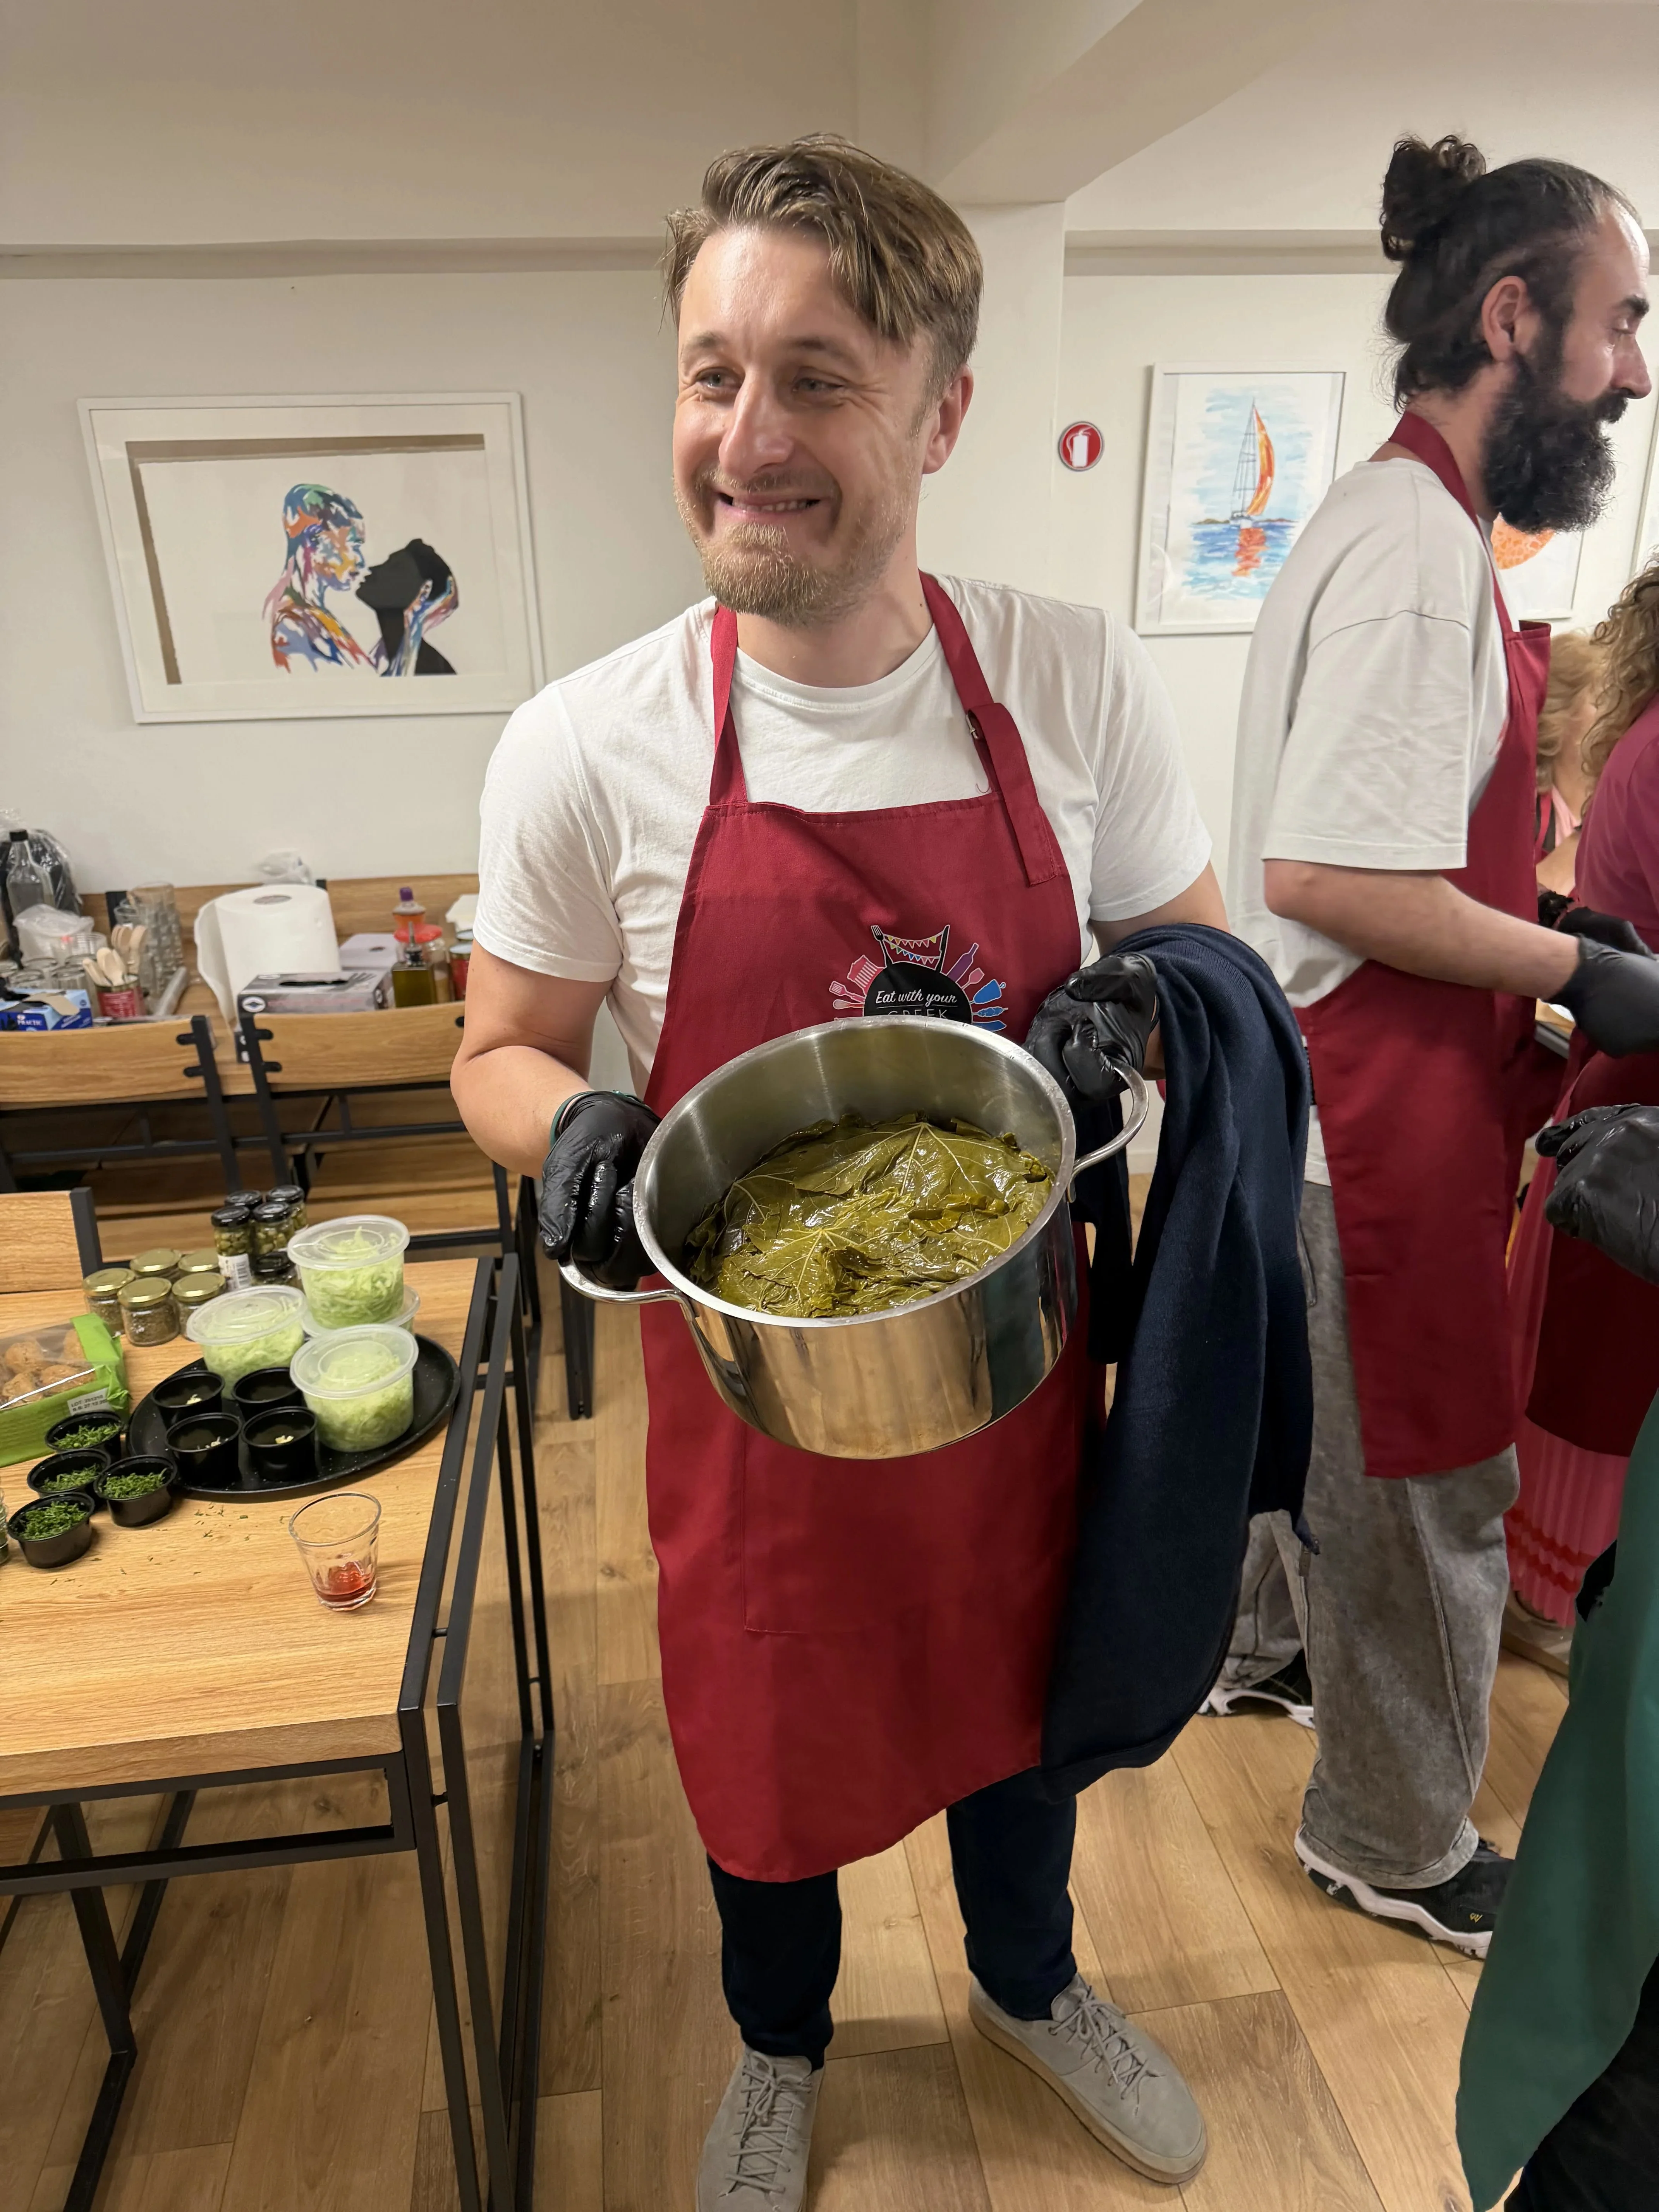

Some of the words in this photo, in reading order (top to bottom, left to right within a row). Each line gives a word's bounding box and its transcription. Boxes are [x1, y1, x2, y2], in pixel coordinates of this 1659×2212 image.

[876, 990, 896, 1004] Eat
[898, 988, 924, 1002] with
[925, 993, 957, 1007] your
